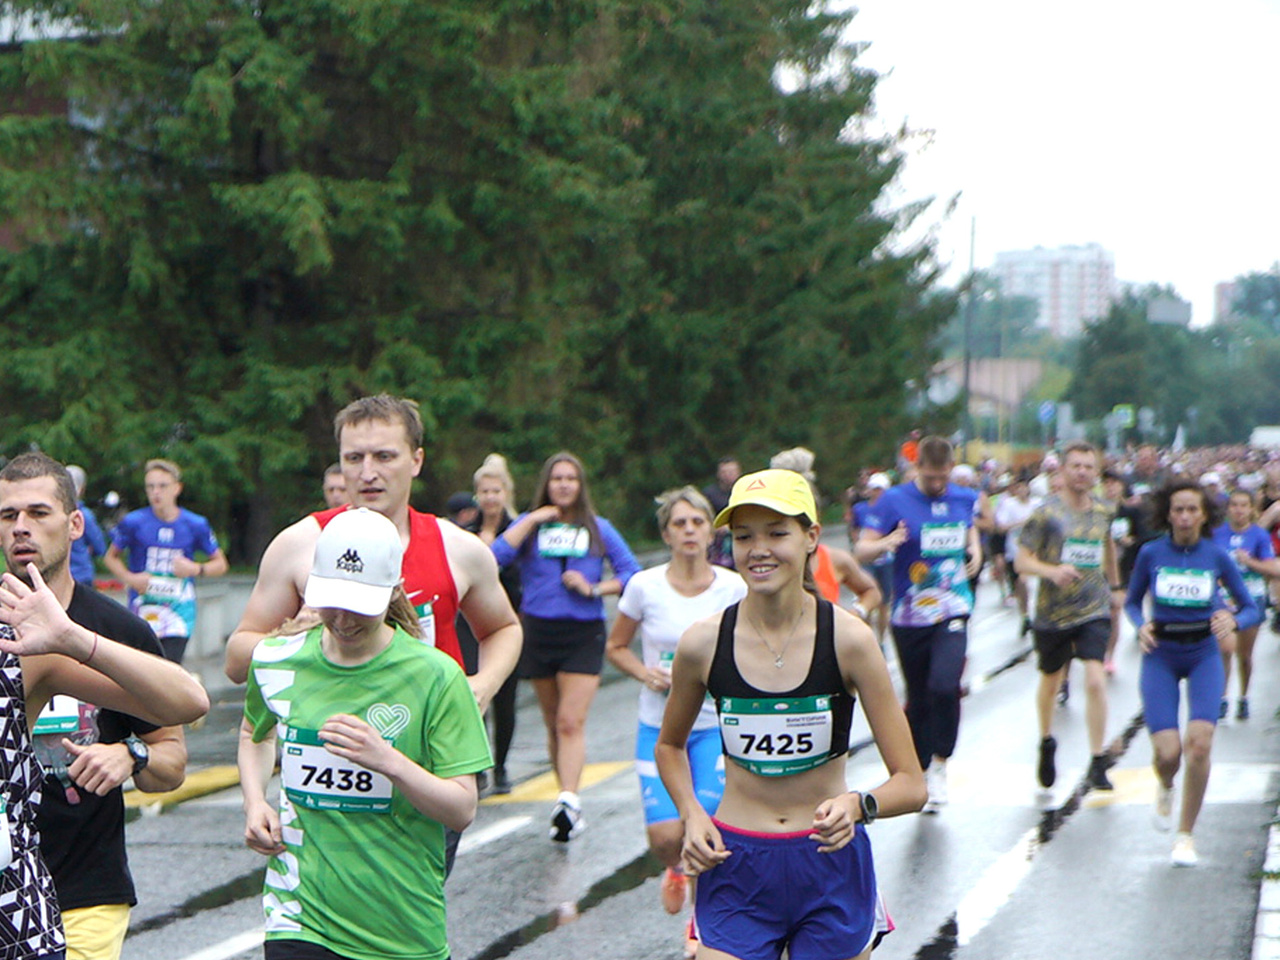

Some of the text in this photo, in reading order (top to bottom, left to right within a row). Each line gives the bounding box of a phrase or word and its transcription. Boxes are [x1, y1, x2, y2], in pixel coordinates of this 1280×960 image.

[336, 559, 364, 573] Kappa
[740, 732, 814, 755] 7425
[301, 765, 373, 792] 7438
